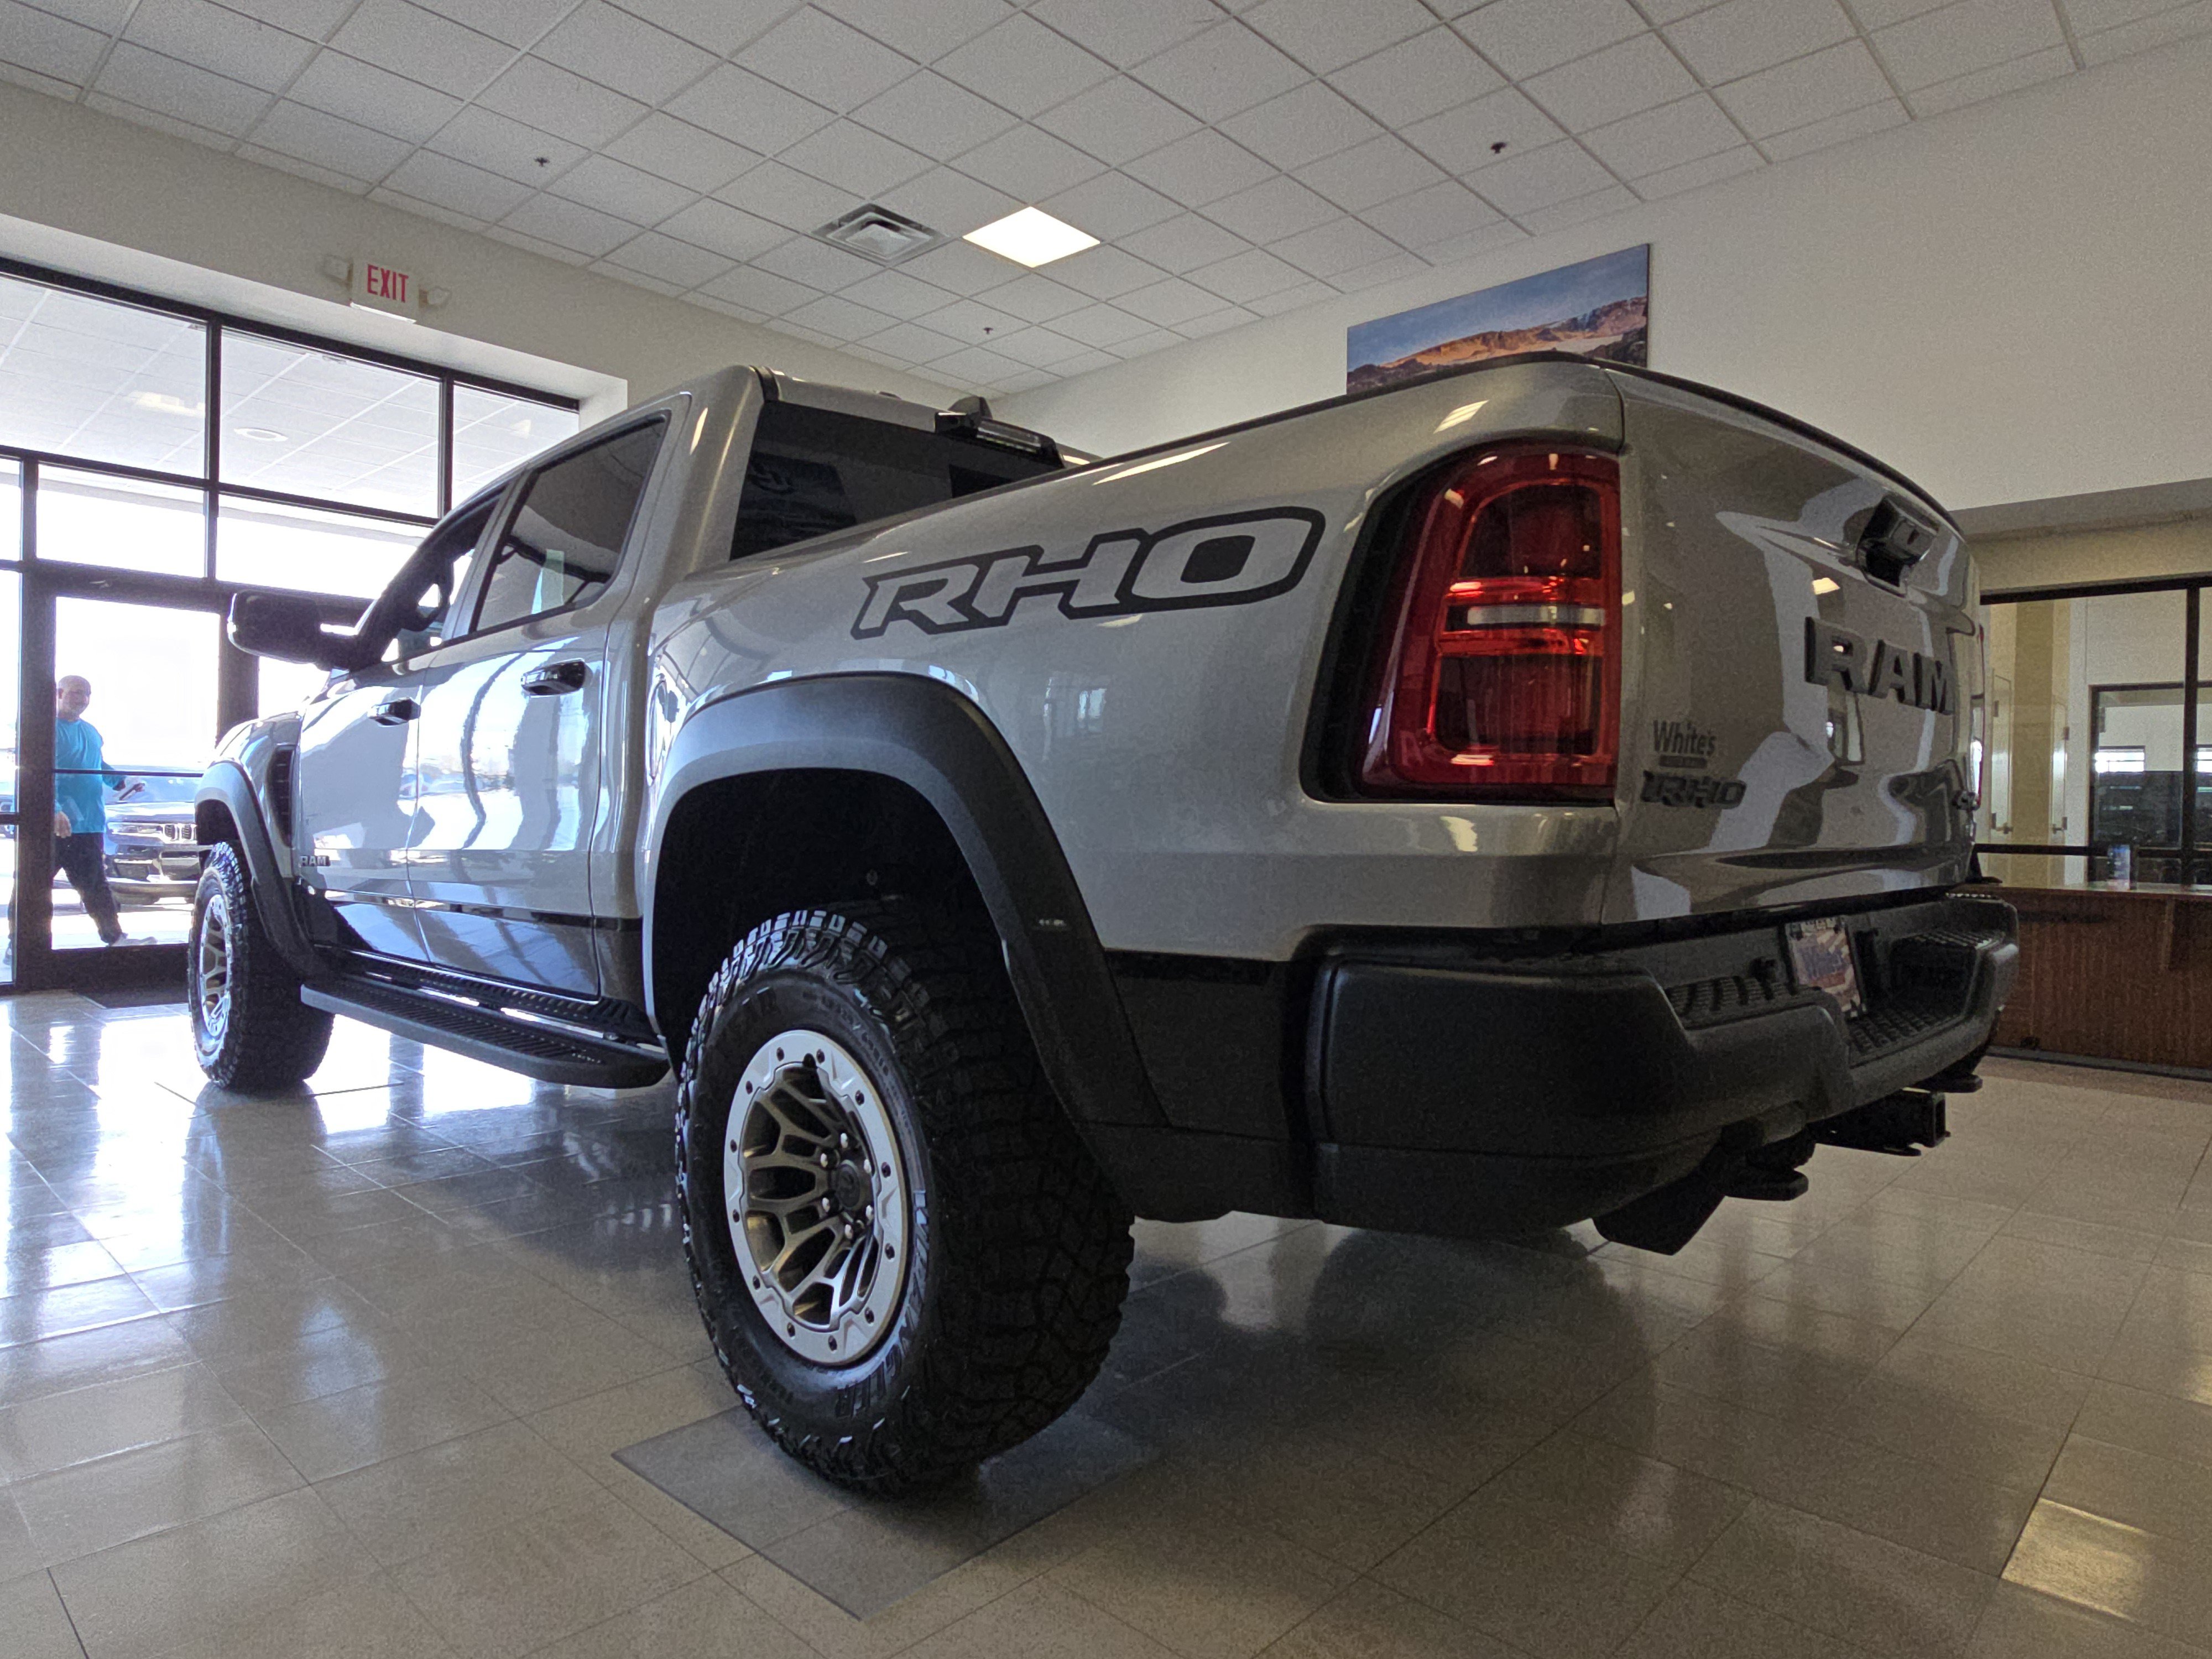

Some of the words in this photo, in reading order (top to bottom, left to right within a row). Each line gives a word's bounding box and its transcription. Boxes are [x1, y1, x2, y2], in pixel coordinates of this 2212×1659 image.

[367, 264, 409, 302] EXIT
[849, 505, 1327, 640] RHO
[1804, 615, 1956, 716] RAM
[1640, 769, 1746, 808] RHO
[300, 855, 330, 867] RAM
[835, 1190, 931, 1419] WRANGLER
